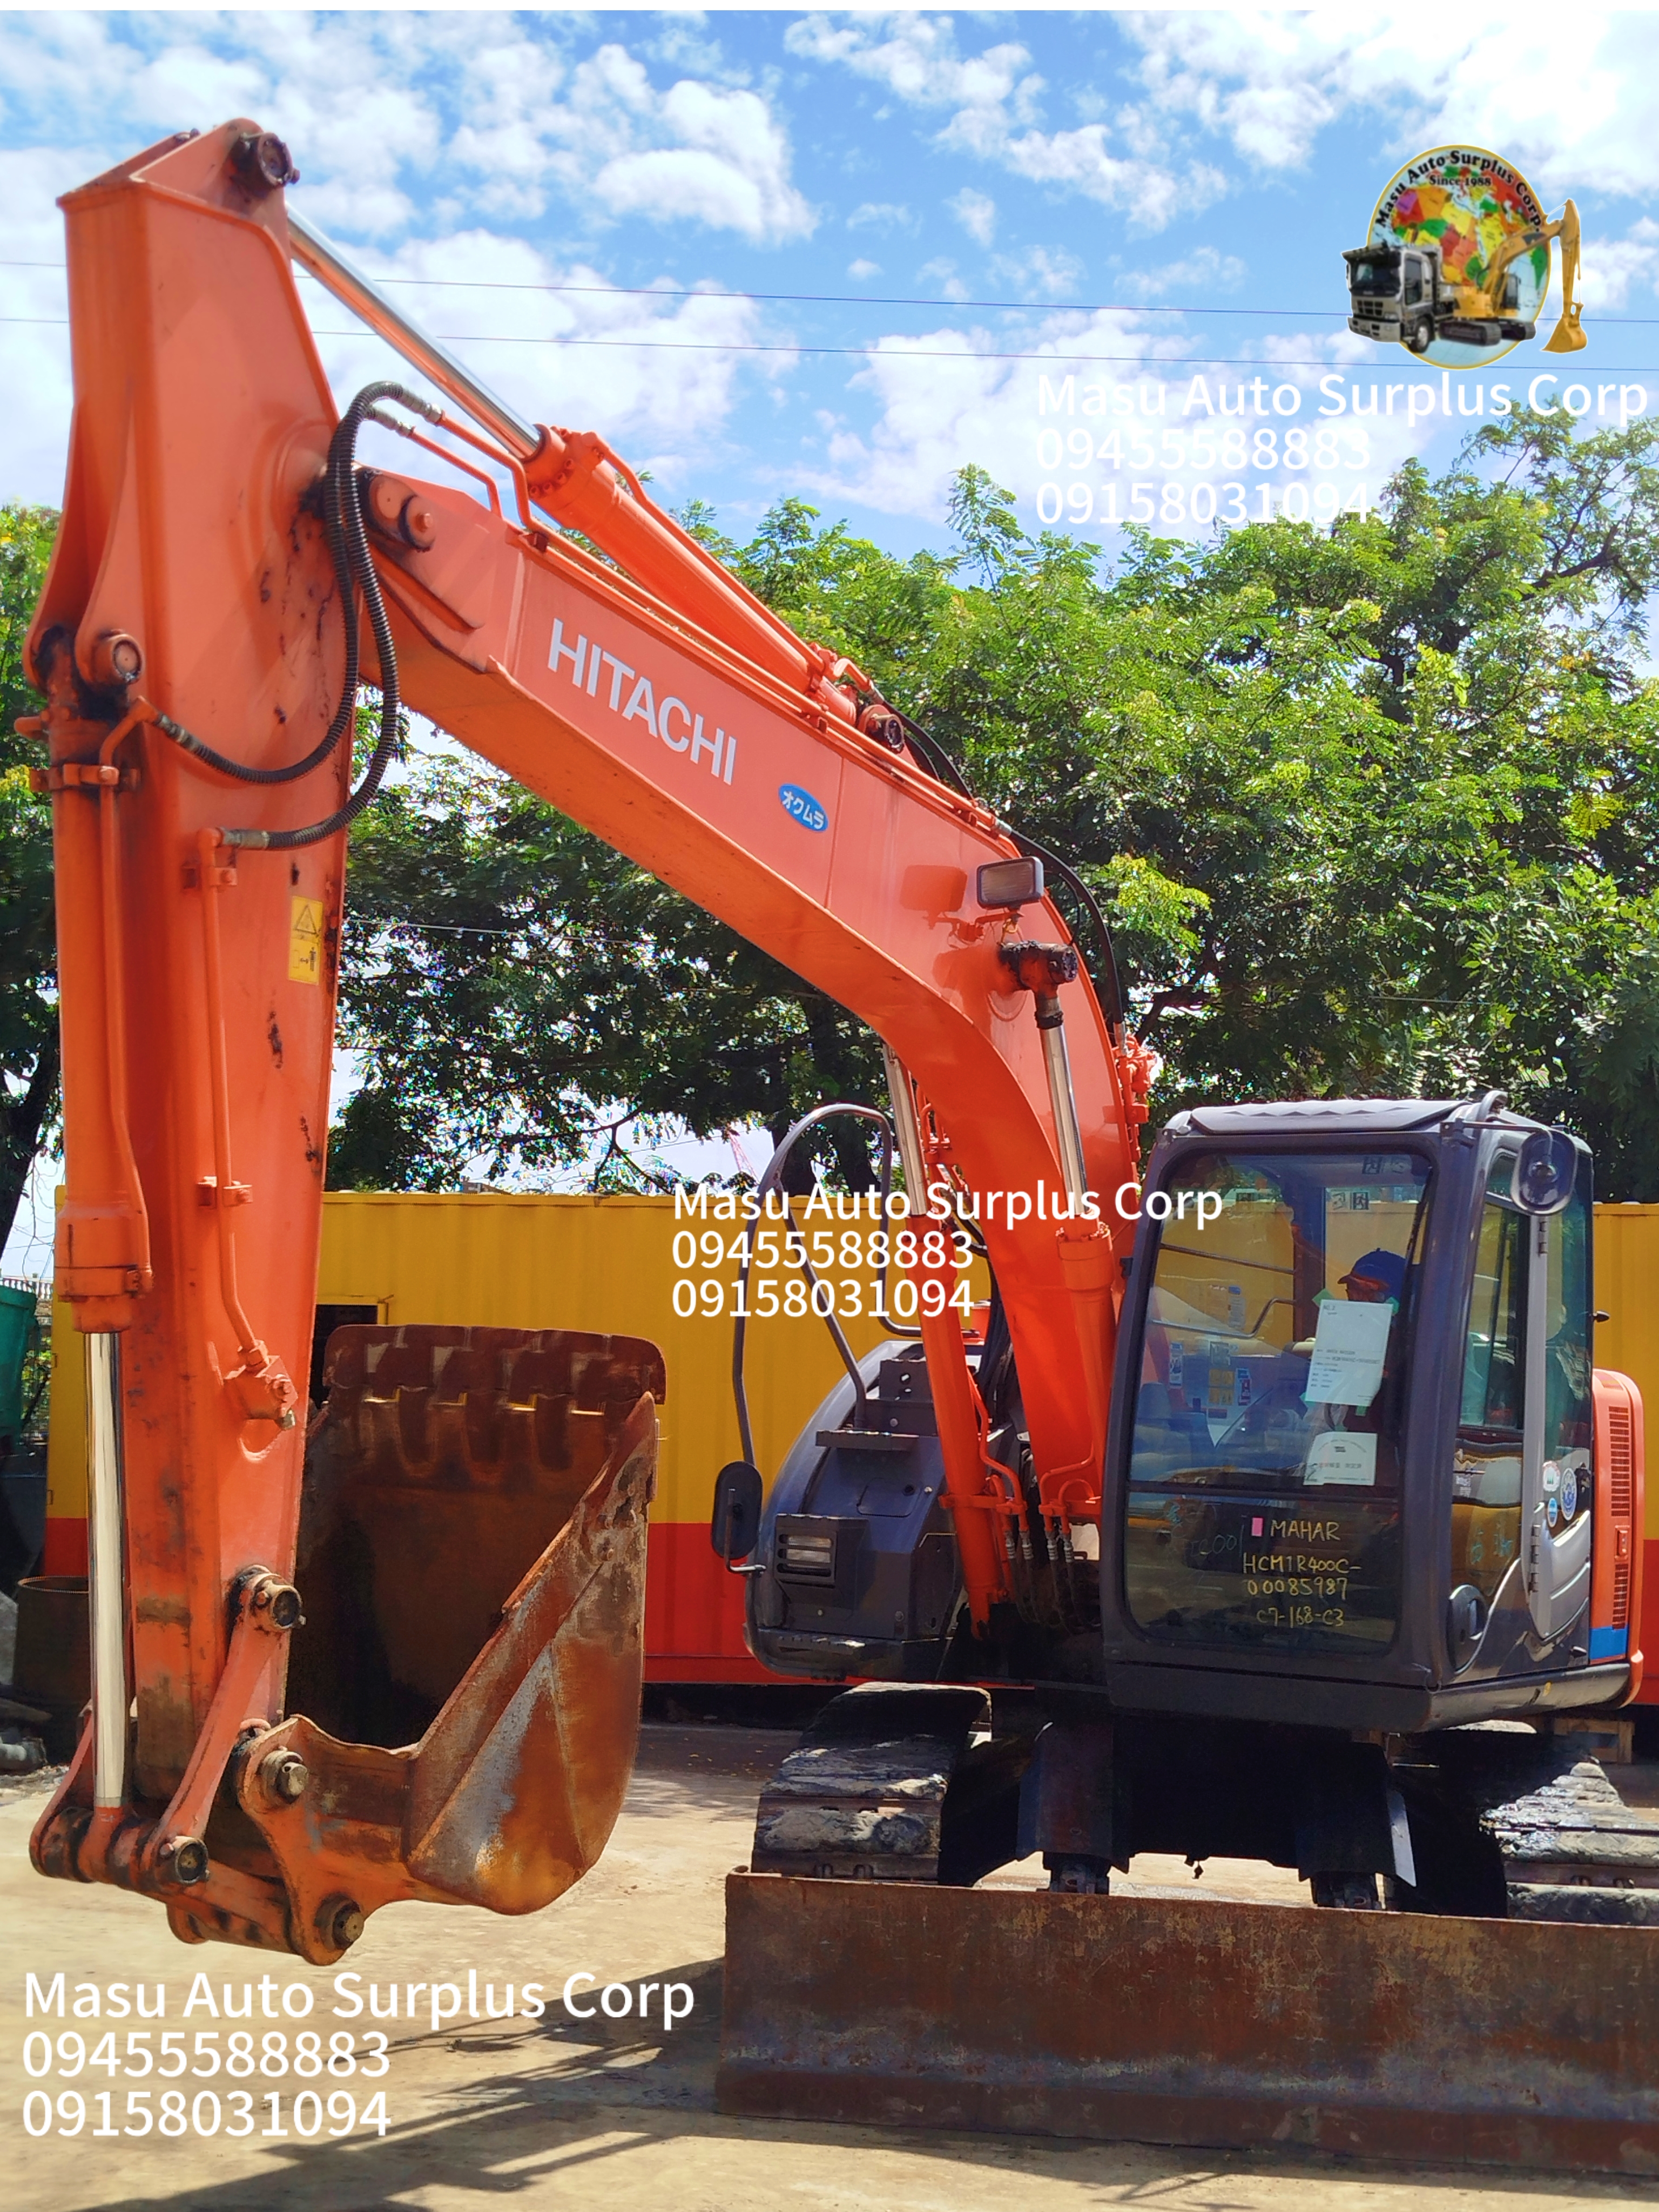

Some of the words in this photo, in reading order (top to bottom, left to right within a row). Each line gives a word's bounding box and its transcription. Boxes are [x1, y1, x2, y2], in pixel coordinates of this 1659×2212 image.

[547, 617, 737, 786] HITACHI
[782, 791, 825, 830] オクムラ
[1270, 1519, 1341, 1542] MAHAR
[1246, 1576, 1348, 1601] 00085987
